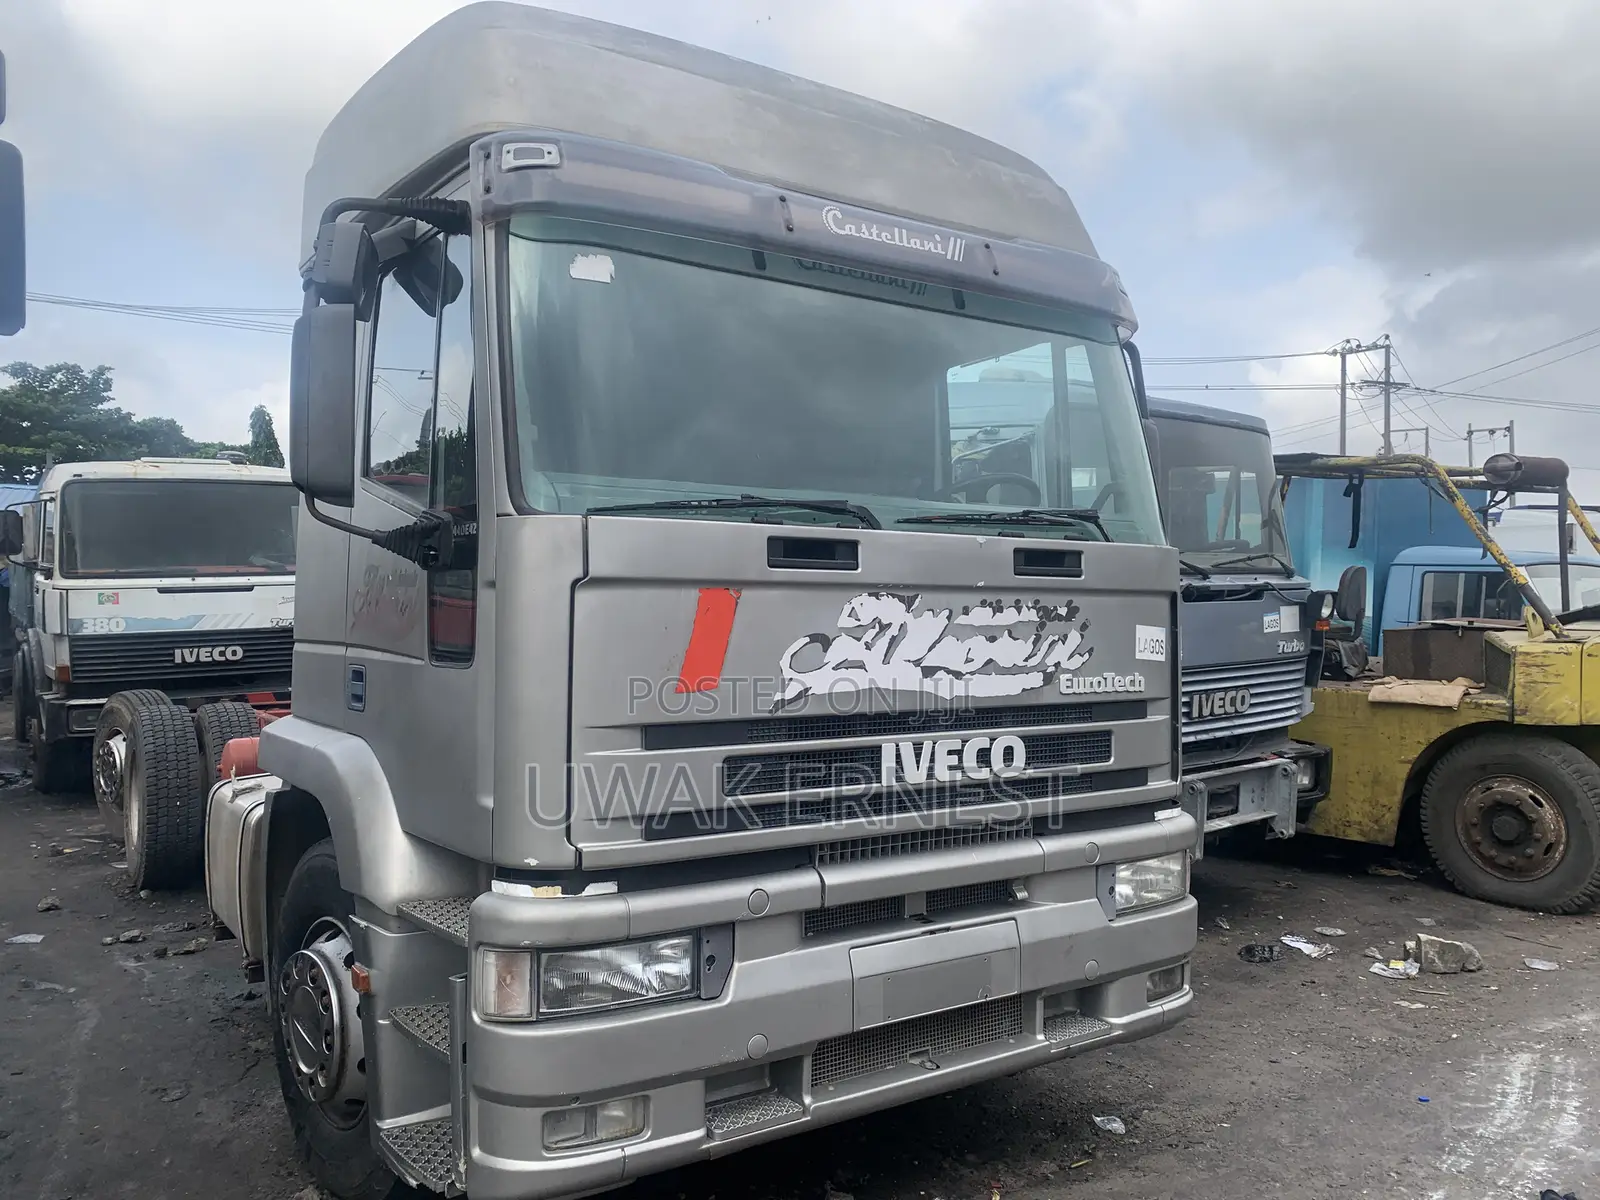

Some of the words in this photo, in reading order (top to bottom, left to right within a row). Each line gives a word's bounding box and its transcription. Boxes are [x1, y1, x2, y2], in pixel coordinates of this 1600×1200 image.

[82, 617, 126, 632] 380
[270, 617, 295, 628] Tur
[1264, 618, 1279, 630] LAGOS
[174, 645, 244, 664] IVECO
[1138, 637, 1164, 655] LAGOS
[1277, 638, 1305, 655] Turbo
[1059, 672, 1145, 694] EuroTech
[1191, 687, 1251, 718] IVECO
[881, 735, 1027, 787] IVECO
